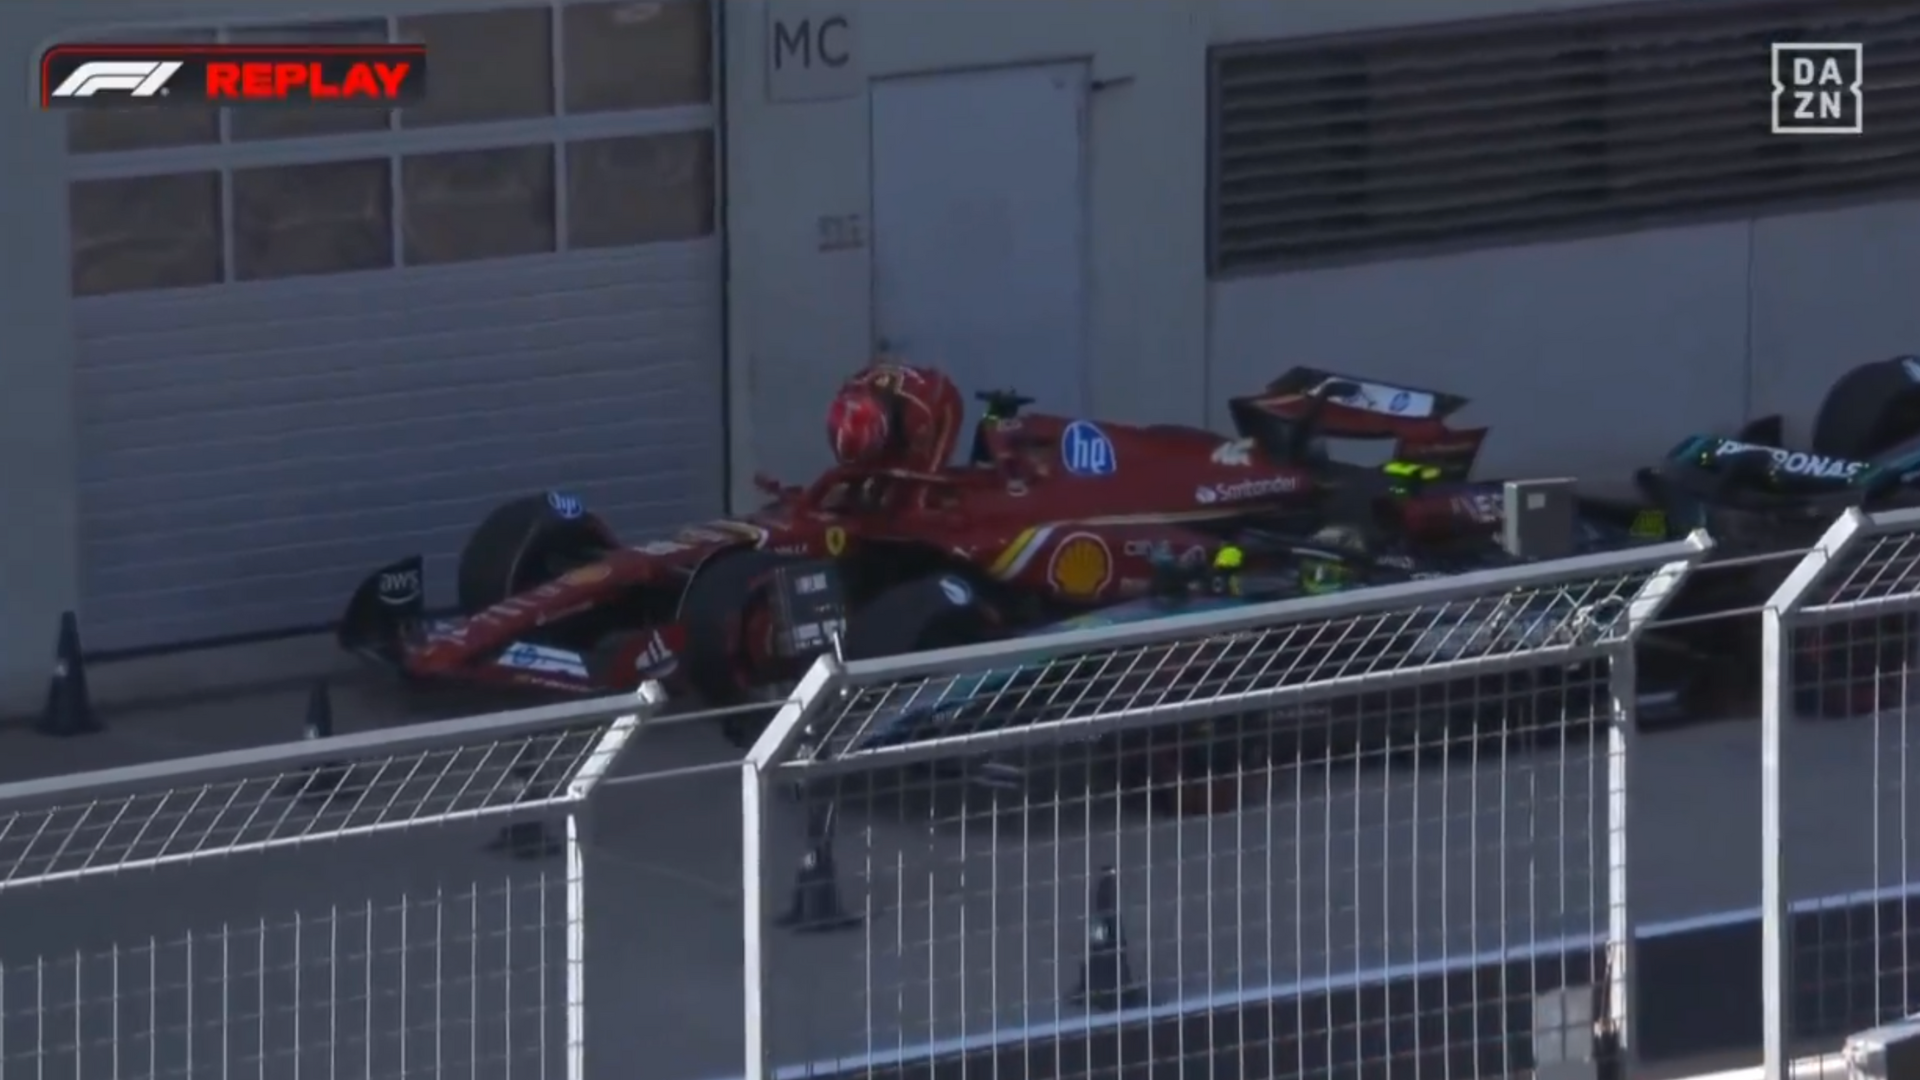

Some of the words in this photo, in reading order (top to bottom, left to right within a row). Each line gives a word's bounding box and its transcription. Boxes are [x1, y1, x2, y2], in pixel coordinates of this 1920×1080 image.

[775, 15, 850, 70] MC
[1217, 477, 1296, 500] Santander
[380, 569, 419, 592] aws
